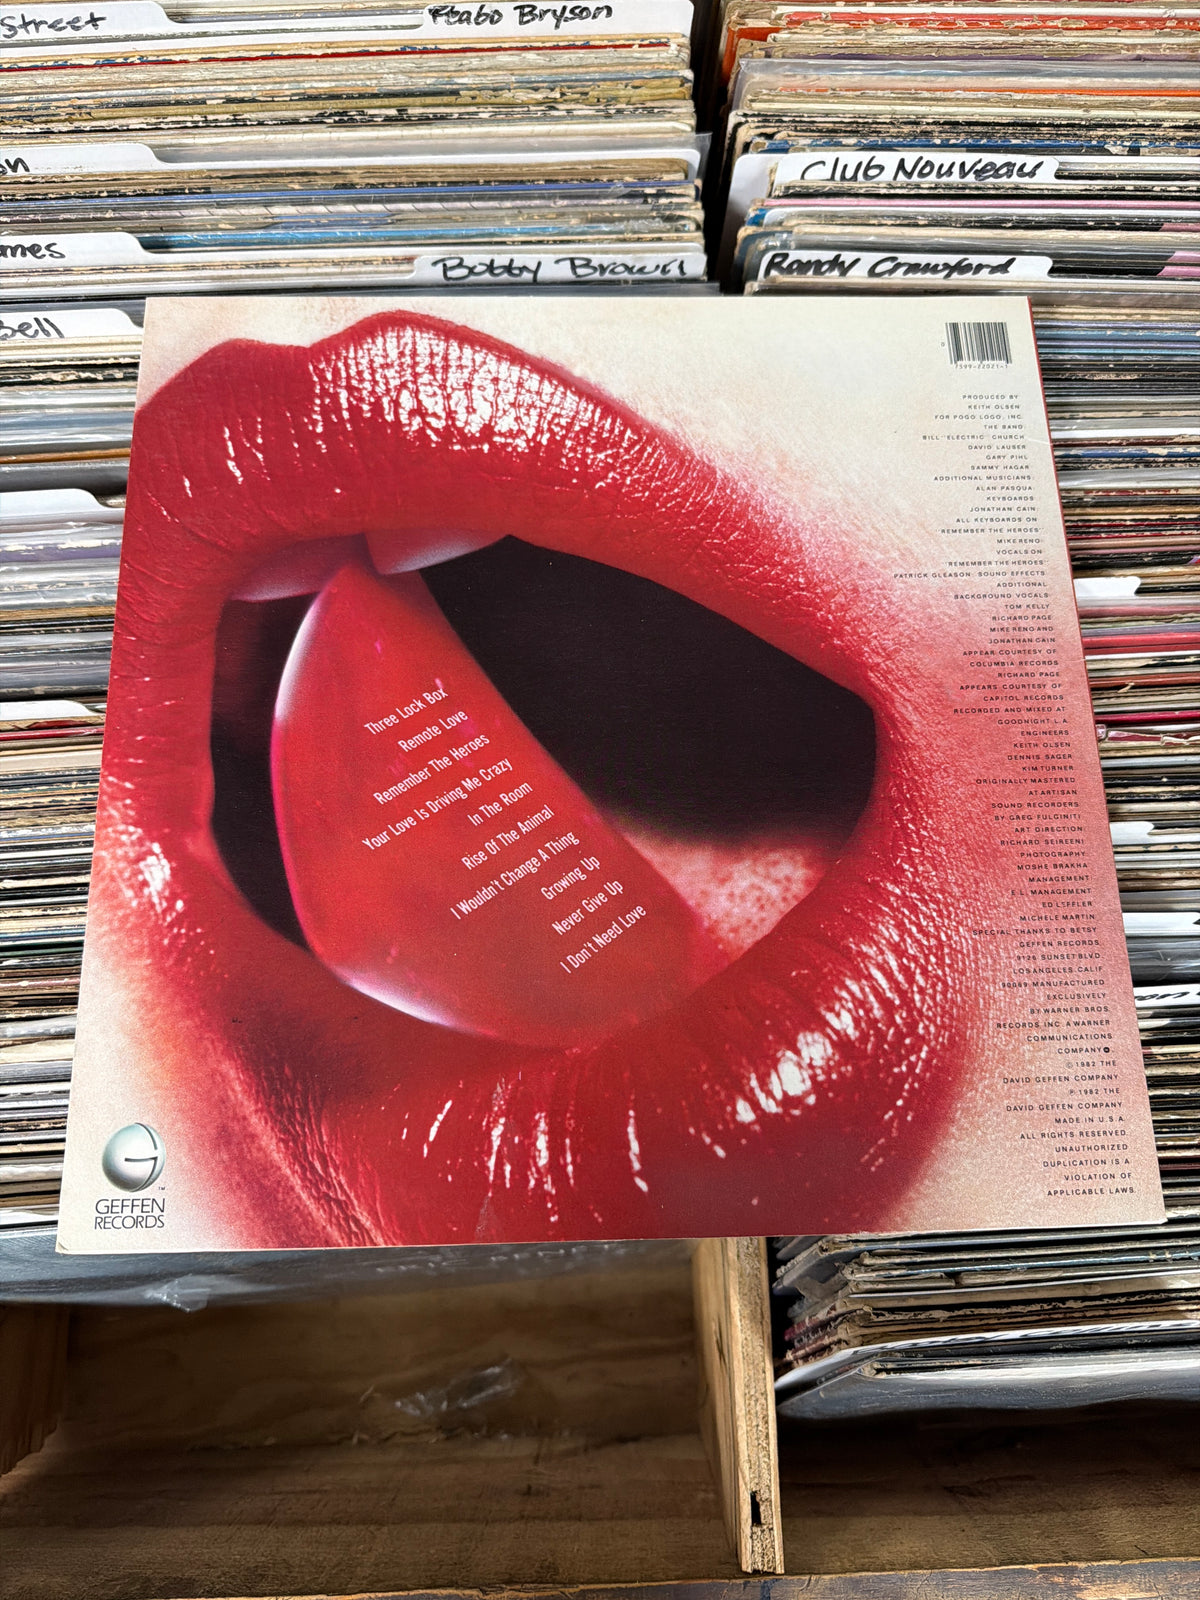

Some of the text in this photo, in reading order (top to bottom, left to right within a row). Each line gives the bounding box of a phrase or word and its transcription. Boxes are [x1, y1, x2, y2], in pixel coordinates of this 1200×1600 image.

[0, 11, 107, 39] Street
[513, 4, 613, 30] Bryson
[799, 156, 1045, 182] Club Nouveau
[431, 256, 687, 283] Bobby Brown
[868, 256, 1017, 280] Crawford
[364, 686, 449, 735] Three Lock Box
[397, 709, 468, 753] Remote Love
[373, 733, 490, 805] Remember The Heroes
[362, 757, 513, 852] Your Love Is Driving Me Crazy
[467, 781, 533, 826] In The Room
[461, 804, 555, 870] Rise Of The Animal
[450, 830, 580, 920] I Wouldn't Change A Thing
[540, 854, 601, 900] Growing Up
[552, 879, 624, 936] Never Give Up
[559, 903, 647, 974] I Don't Need Love
[1026, 1033, 1113, 1042] COMMUNICATIONS
[1035, 1075, 1070, 1083] GEFFEN
[1038, 1103, 1073, 1111] GEFFEN
[1055, 1144, 1128, 1153] UNAUTHORIZED
[1043, 1159, 1107, 1168] DUPLICATION
[1064, 1173, 1115, 1181] VIOLATION
[1047, 1188, 1105, 1196] APPLICABLE
[94, 1197, 165, 1215] GEFFEN
[94, 1214, 165, 1230] RECORDS
